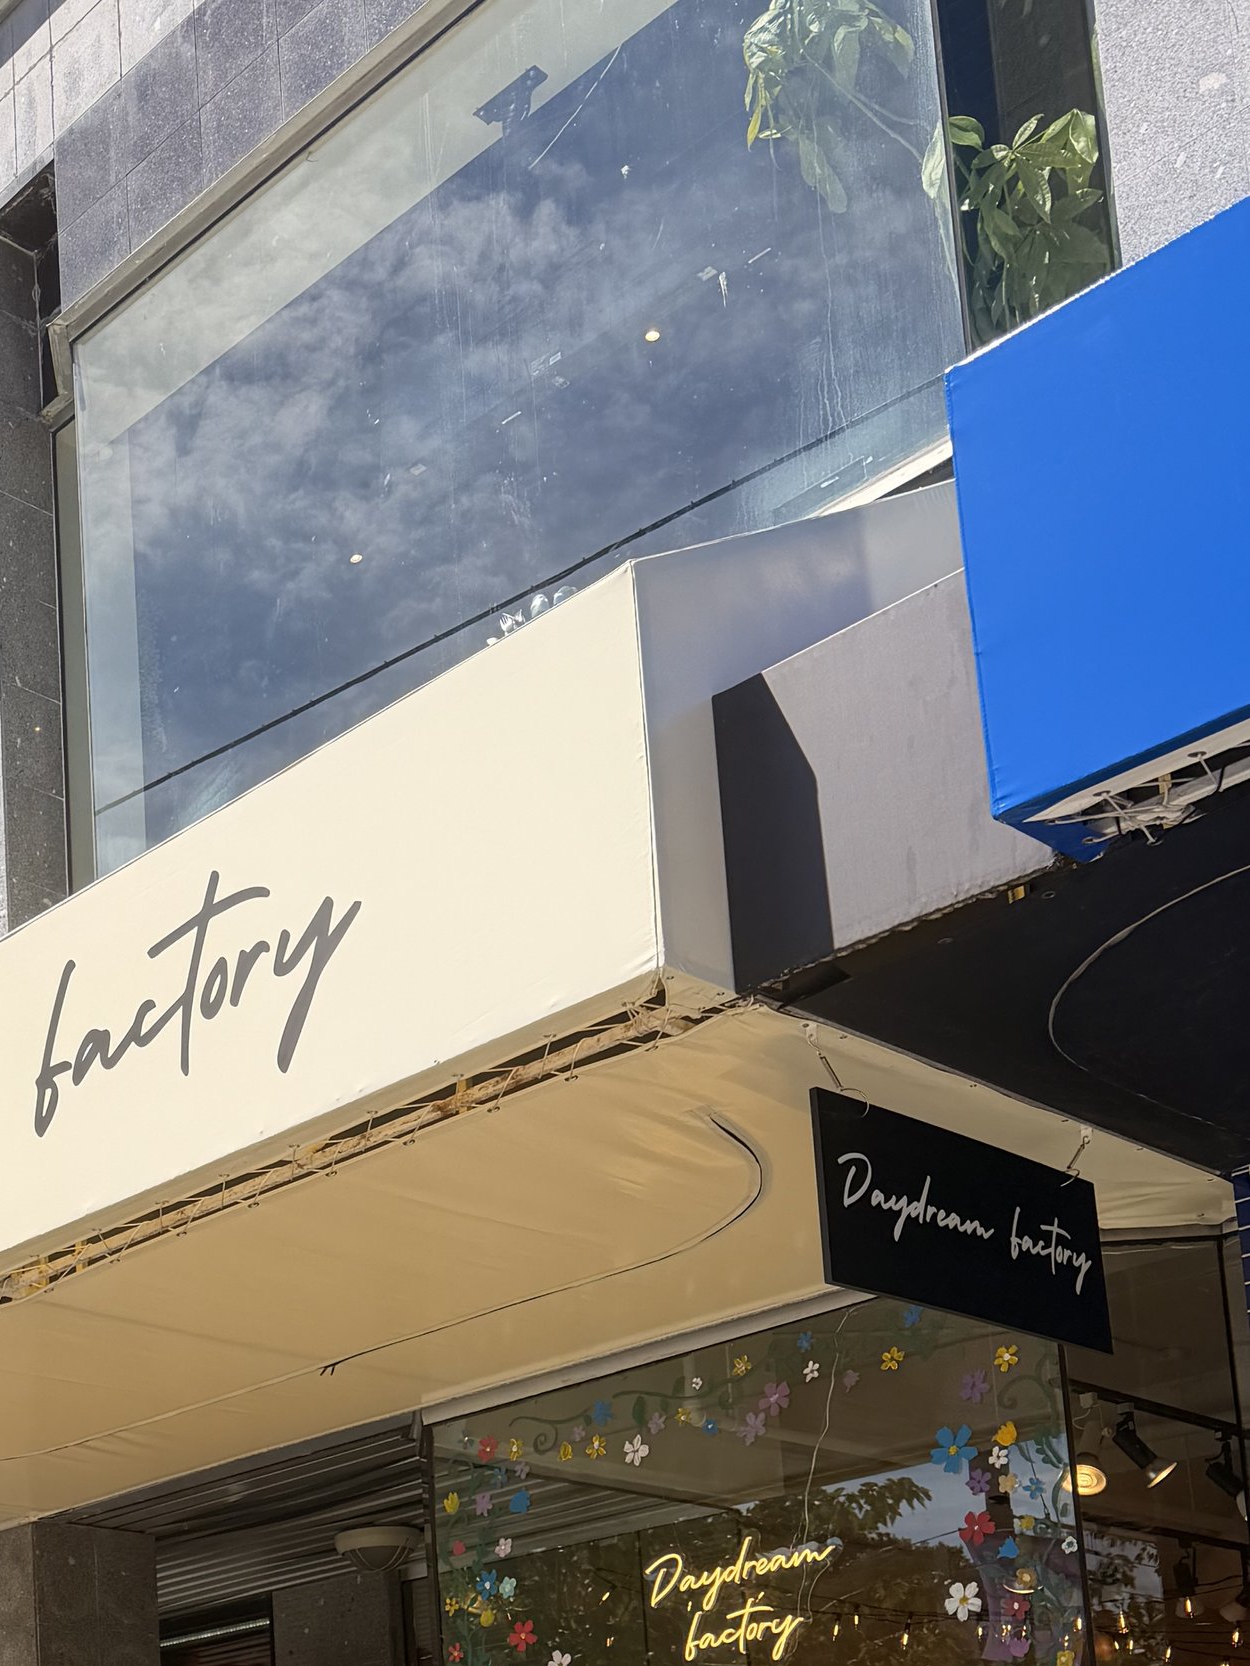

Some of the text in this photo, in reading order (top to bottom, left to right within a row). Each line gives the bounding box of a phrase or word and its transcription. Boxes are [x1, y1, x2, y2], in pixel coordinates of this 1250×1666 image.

[34, 870, 362, 1137] factory
[837, 1152, 1092, 1295] Daydream factory
[644, 1536, 836, 1661] Daydream factory
